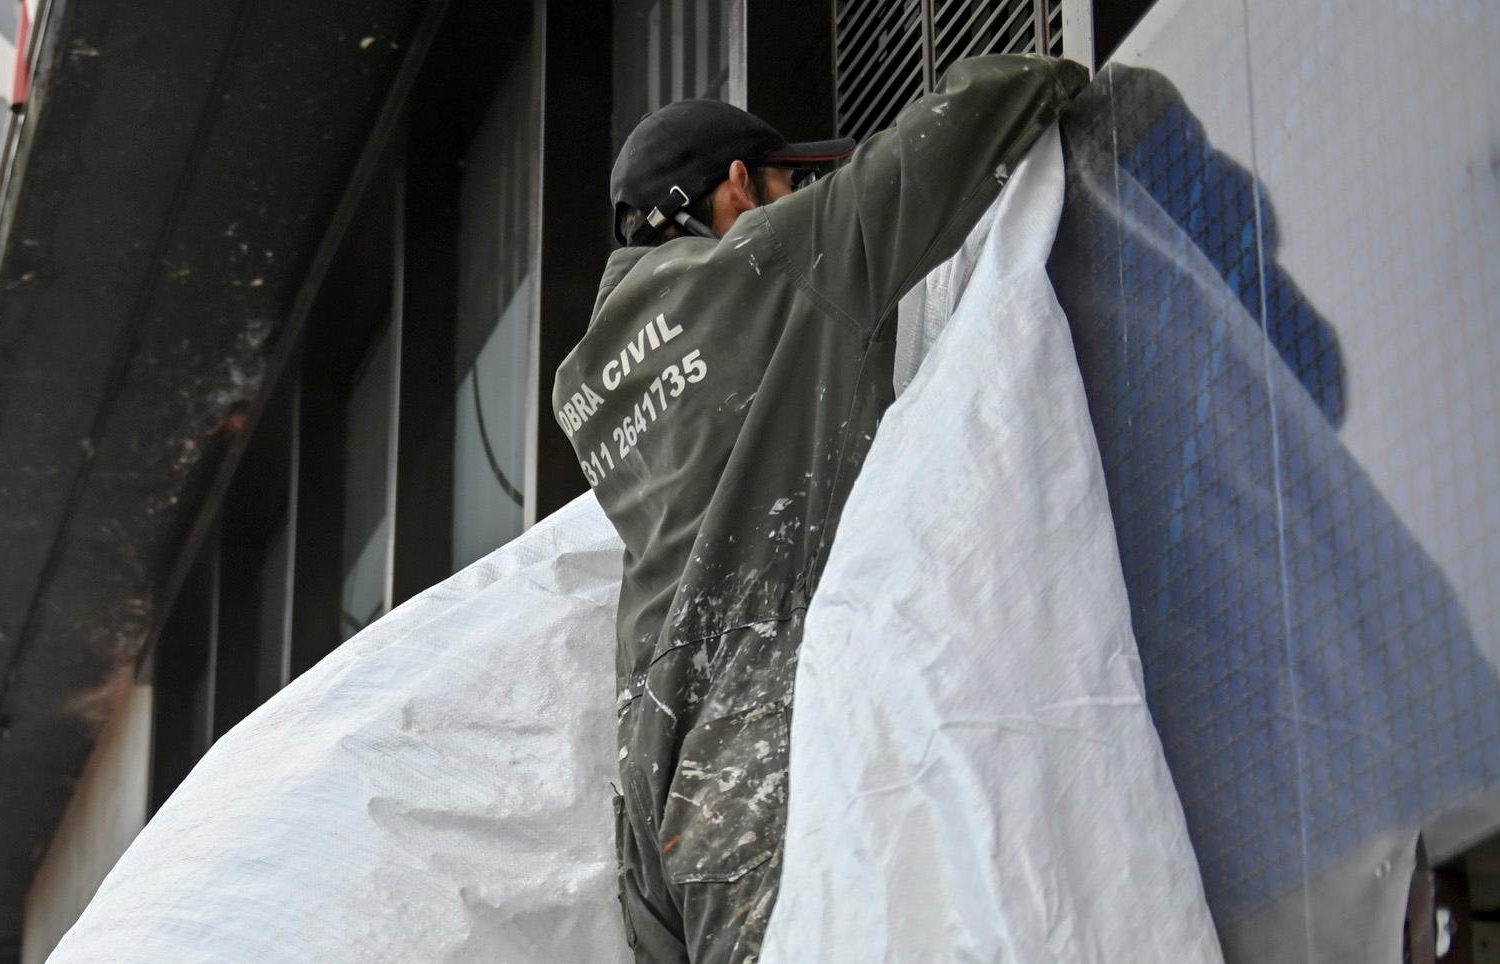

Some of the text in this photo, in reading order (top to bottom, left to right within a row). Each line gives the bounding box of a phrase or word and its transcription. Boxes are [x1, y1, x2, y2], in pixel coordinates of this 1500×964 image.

[559, 313, 683, 437] OBRA CIVIL
[581, 349, 707, 486] 311 2641735
